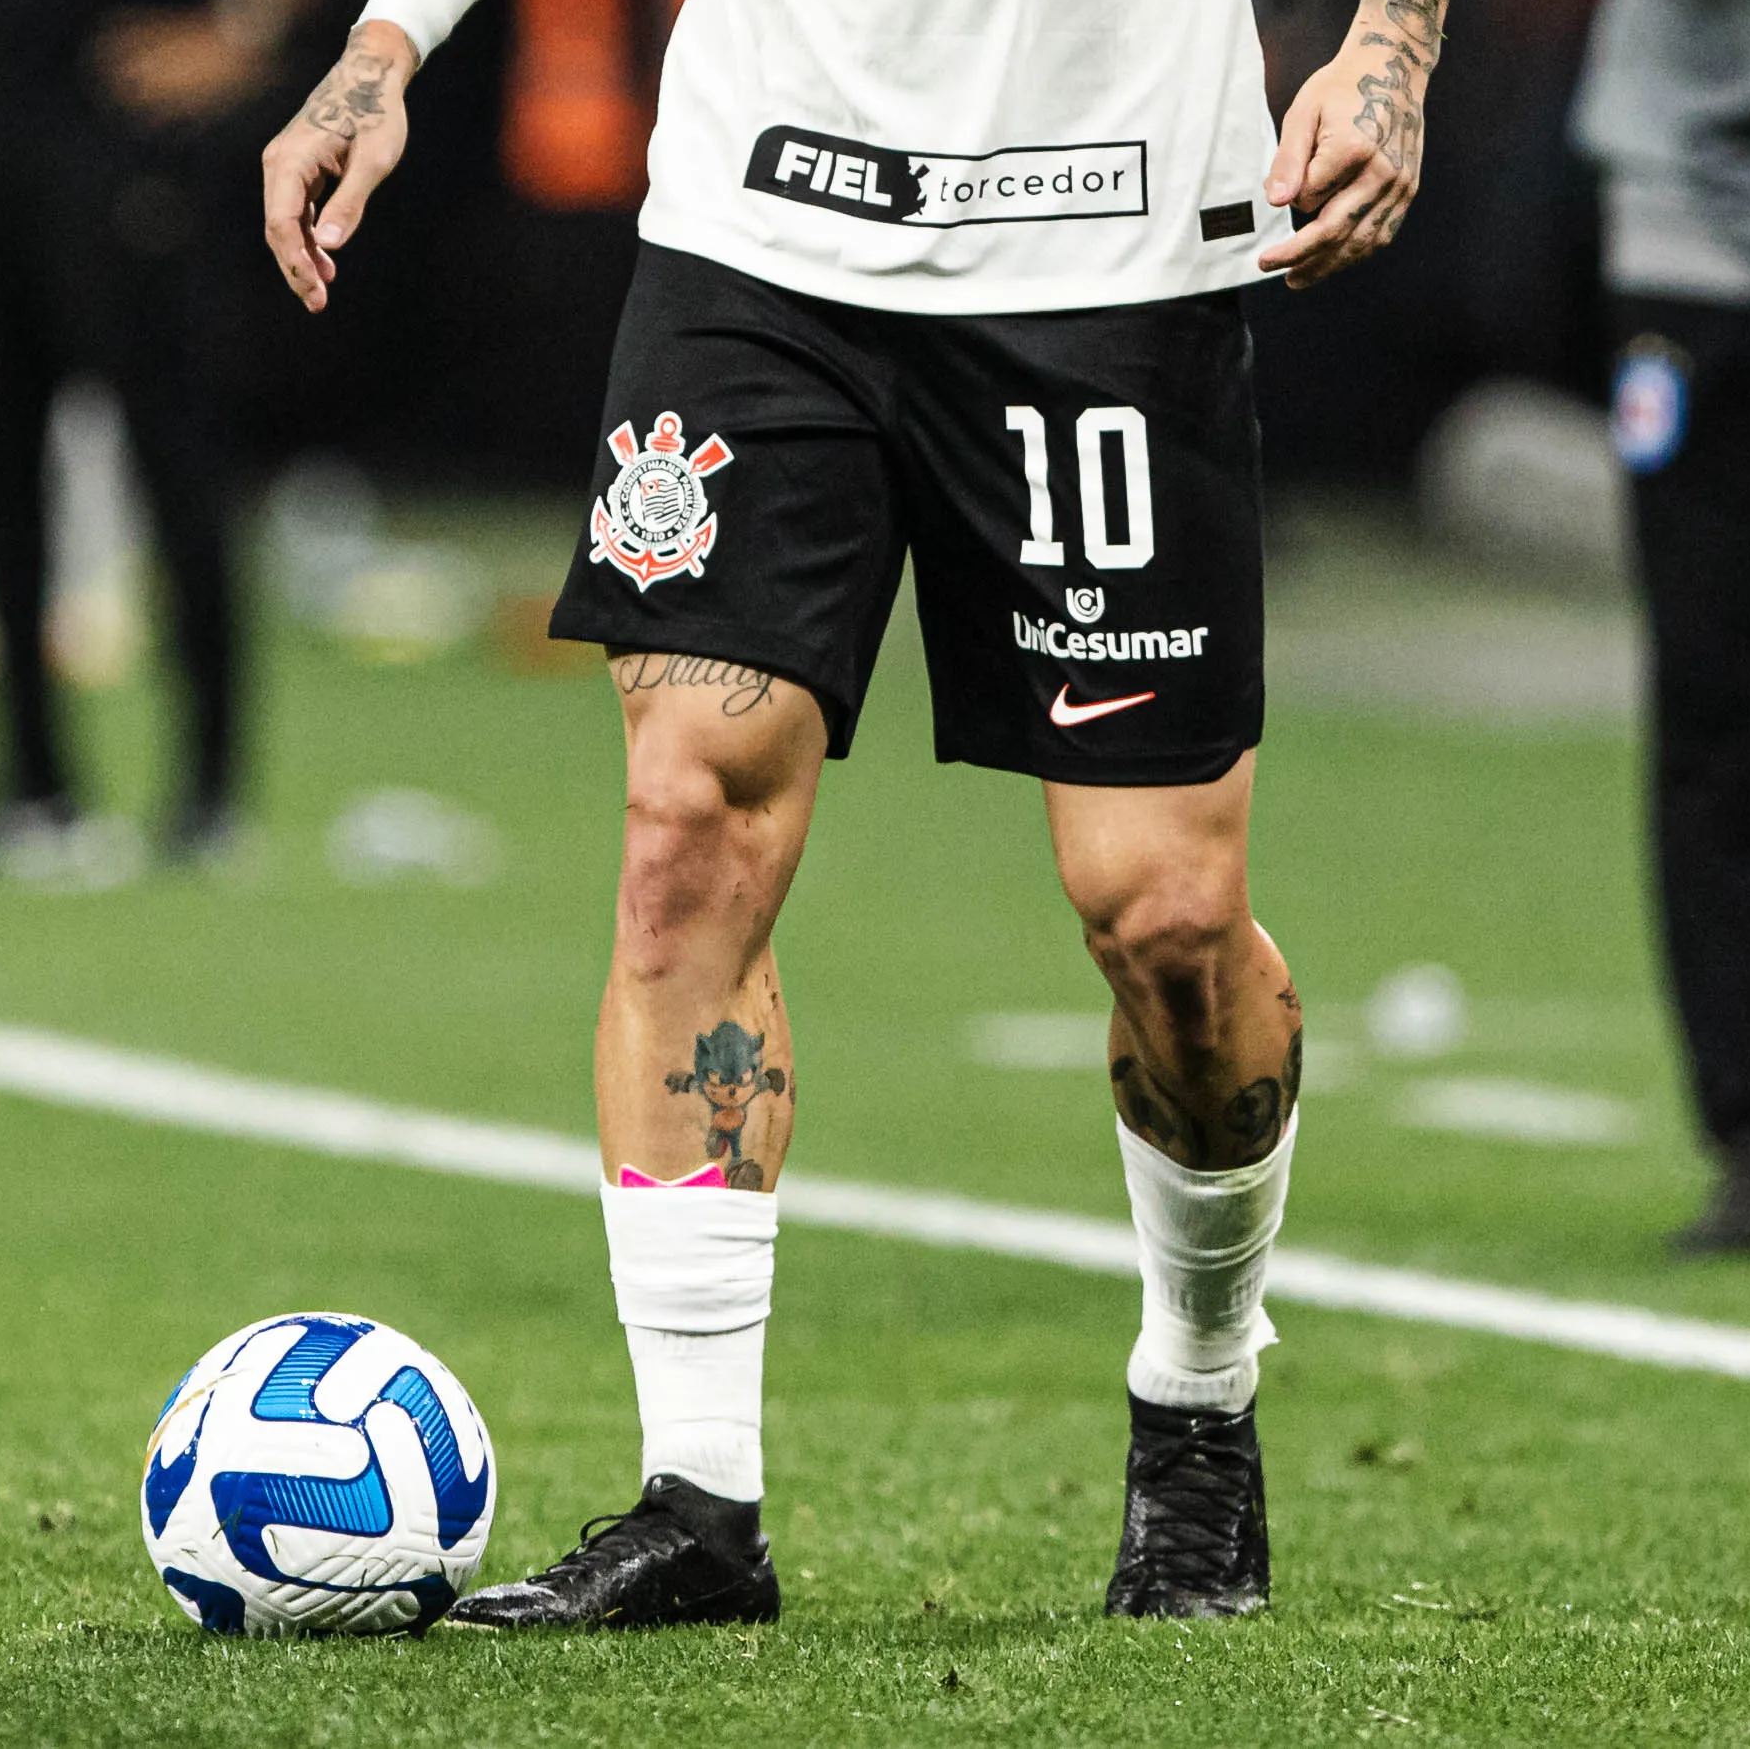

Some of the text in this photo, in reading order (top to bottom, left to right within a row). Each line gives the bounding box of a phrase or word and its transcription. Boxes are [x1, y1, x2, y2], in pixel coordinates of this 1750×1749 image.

[774, 140, 1125, 207] FIEL torcedor
[1005, 405, 1155, 570] 10
[1012, 611, 1209, 661] UniCesumar
